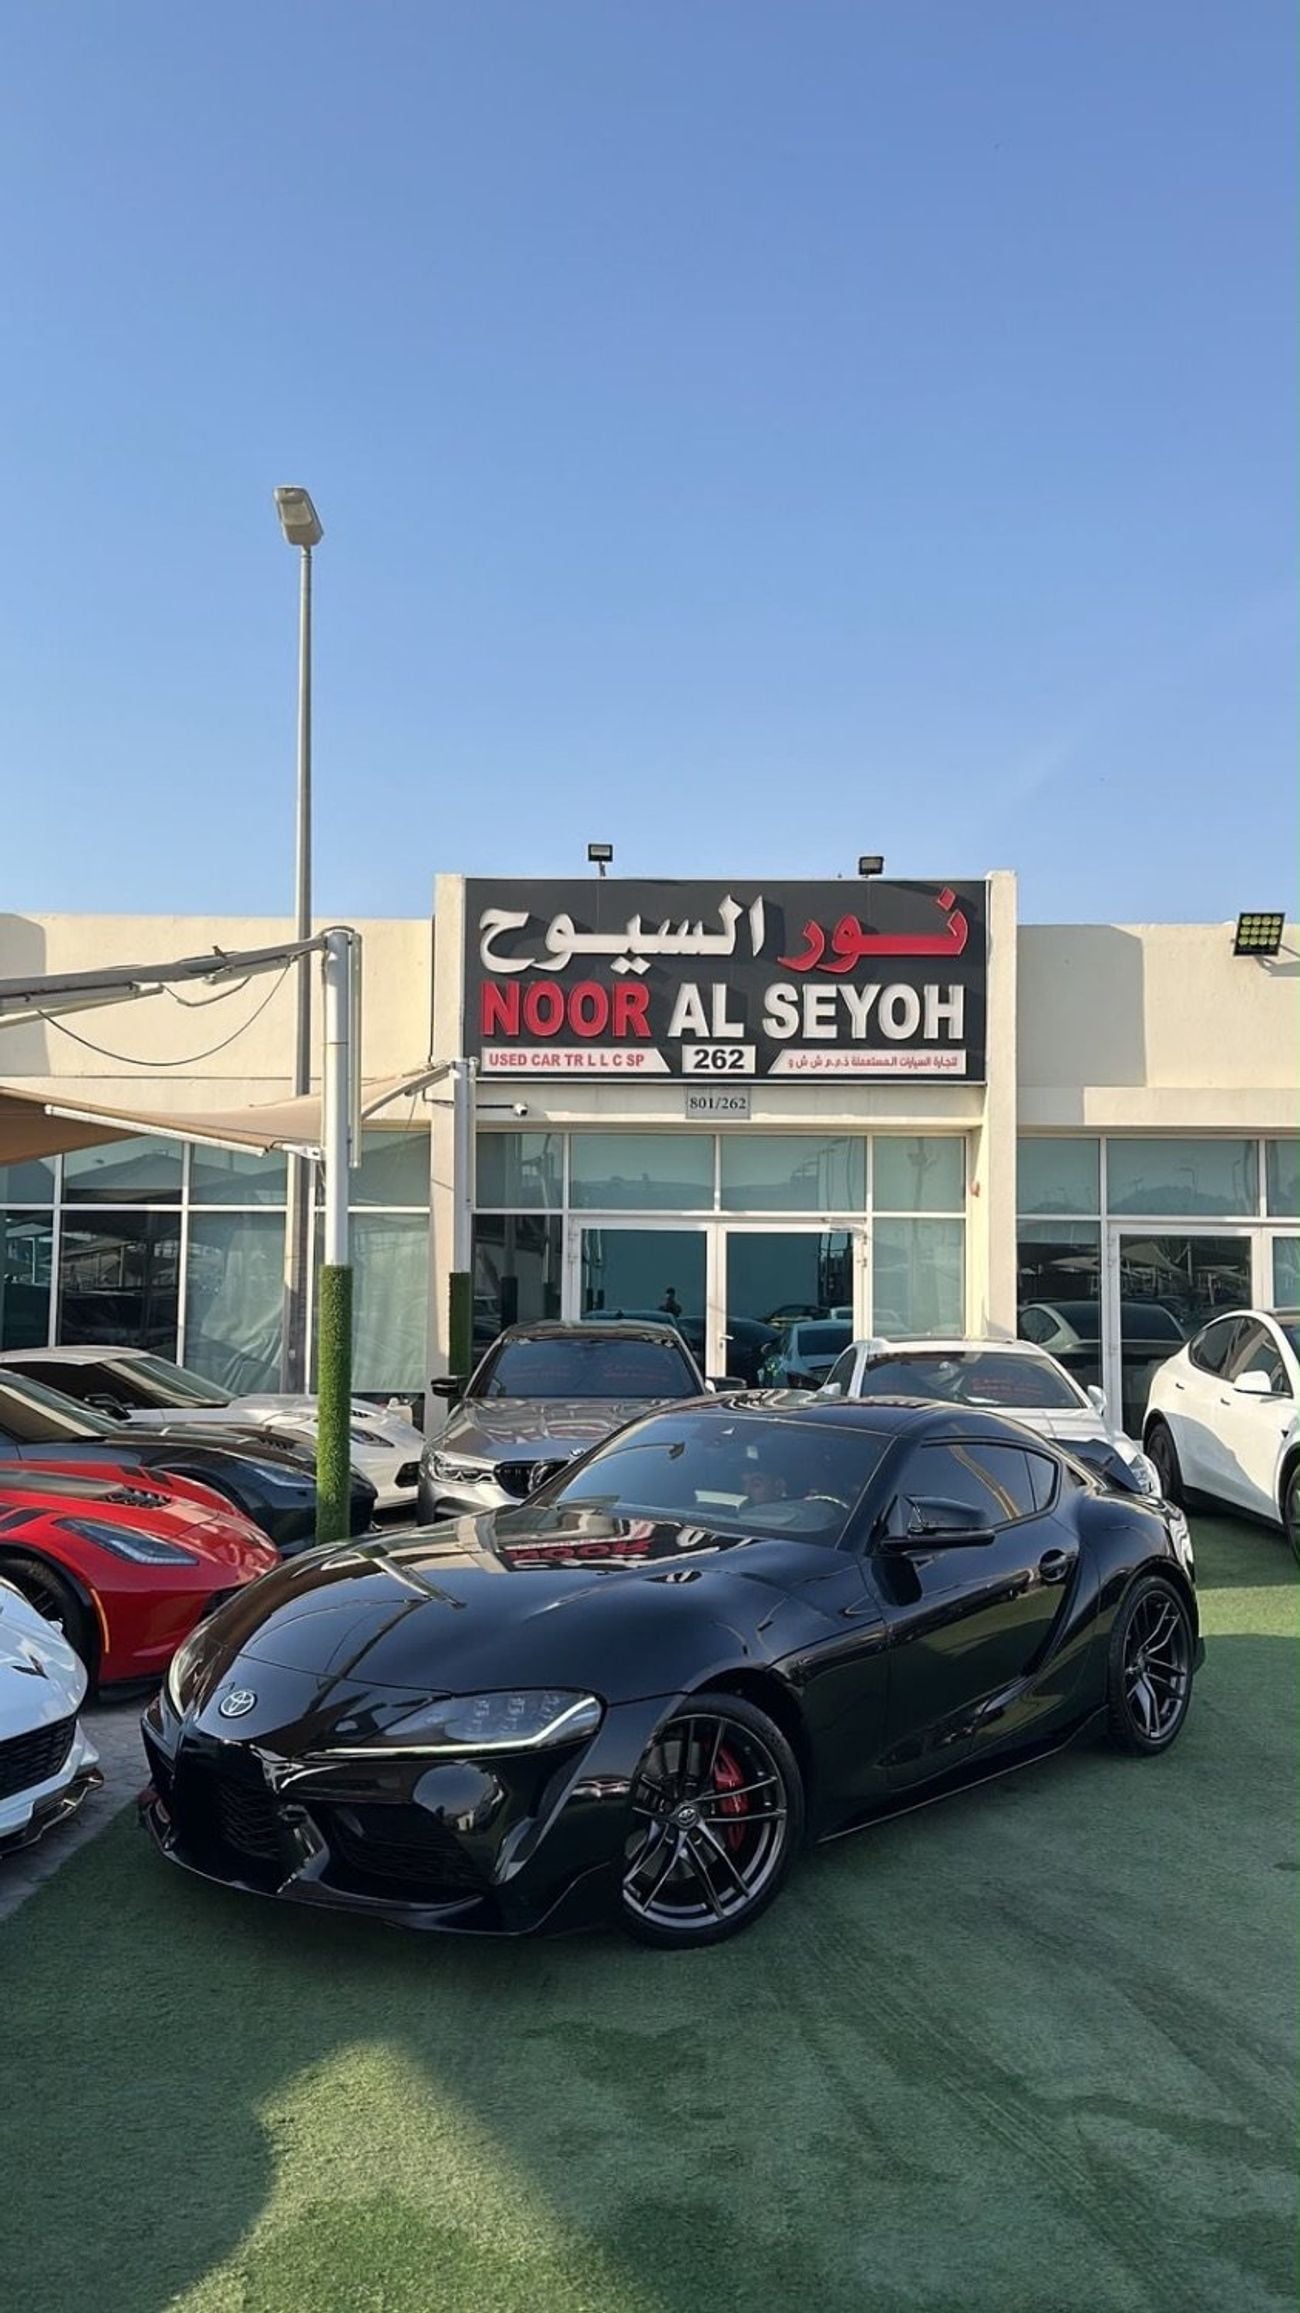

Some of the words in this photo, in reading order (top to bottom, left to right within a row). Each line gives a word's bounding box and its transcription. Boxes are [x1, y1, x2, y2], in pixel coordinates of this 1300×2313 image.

[479, 893, 766, 975] السيوح
[777, 887, 968, 974] نور
[480, 980, 652, 1037] NOOR
[667, 982, 745, 1038] AL
[762, 982, 965, 1040] SEYOH
[488, 1053, 528, 1067] USED
[531, 1053, 561, 1067] CAR
[564, 1053, 584, 1067] TR
[587, 1053, 596, 1067] L
[600, 1053, 608, 1067] L
[612, 1053, 623, 1067] C
[625, 1053, 645, 1067] SP
[693, 1048, 745, 1070] 262
[851, 1055, 897, 1067] المستعملة
[899, 1055, 931, 1069] السيارات
[689, 1096, 747, 1110] 801/262
